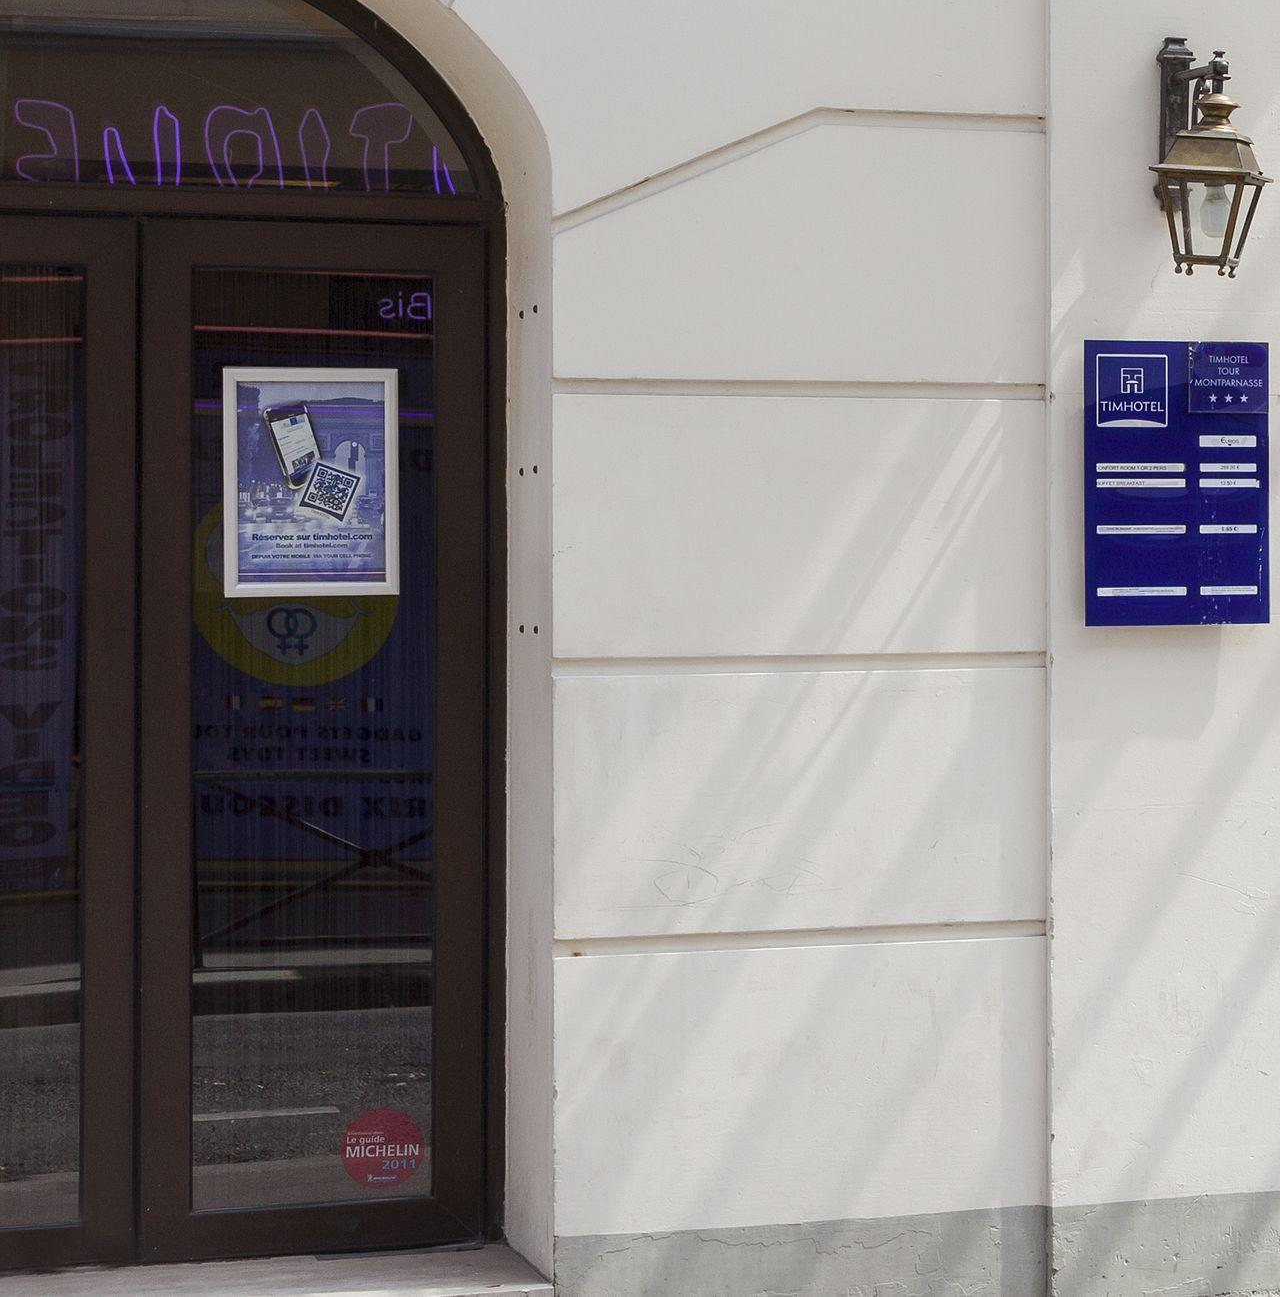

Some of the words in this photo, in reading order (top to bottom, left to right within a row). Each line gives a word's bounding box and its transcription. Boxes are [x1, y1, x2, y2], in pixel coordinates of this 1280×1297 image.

[1209, 355, 1249, 364] TIMHOTEL
[1218, 367, 1240, 376] TOUR
[1194, 378, 1263, 388] MONTPARNASSE
[1100, 400, 1165, 413] TIMHOTEL
[252, 533, 294, 541] Réservez
[313, 533, 373, 541] timhotel.com
[346, 1136, 357, 1144] Le
[359, 1135, 386, 1145] guide
[346, 1144, 420, 1159] MICHELIN
[382, 1158, 417, 1170] 2011
